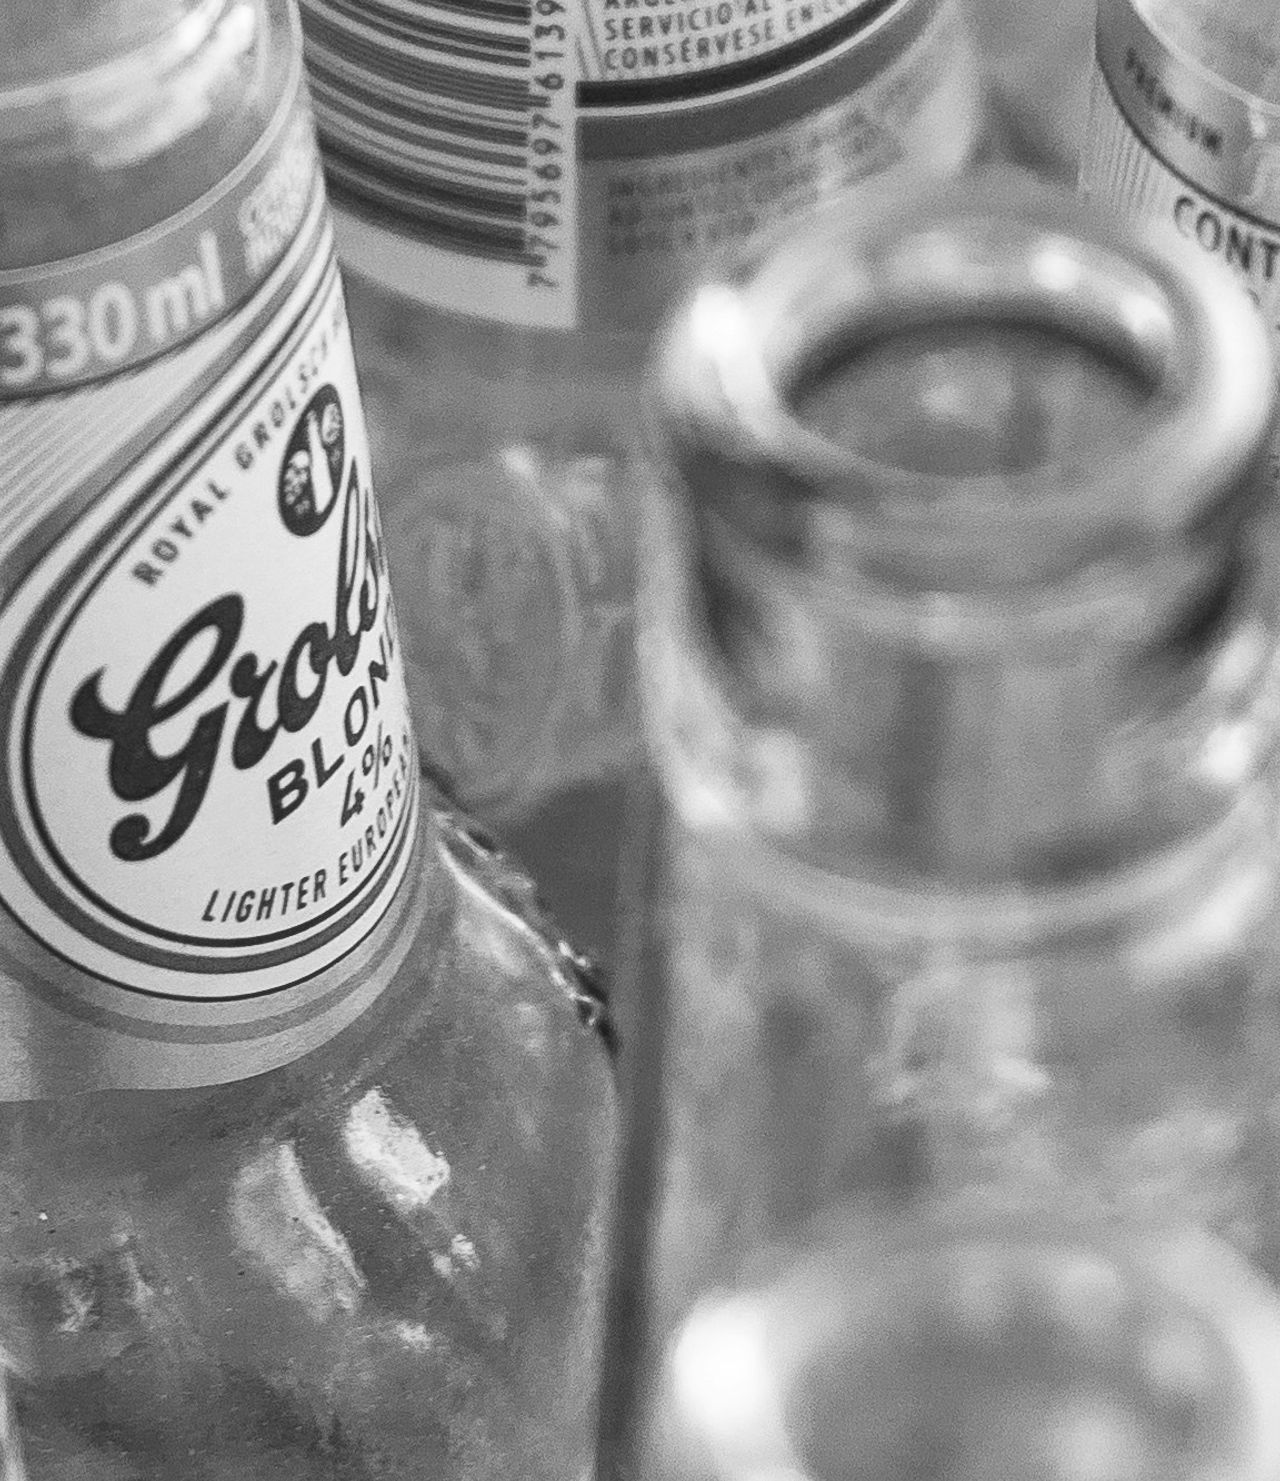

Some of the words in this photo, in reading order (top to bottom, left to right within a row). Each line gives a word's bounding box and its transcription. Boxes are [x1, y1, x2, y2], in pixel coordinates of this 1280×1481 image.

[604, 2, 733, 42] SERVICIO
[130, 478, 231, 587] ROYAL
[68, 454, 392, 864] Grols
[339, 720, 393, 829] 4%
[201, 867, 328, 923] LIGHTER
